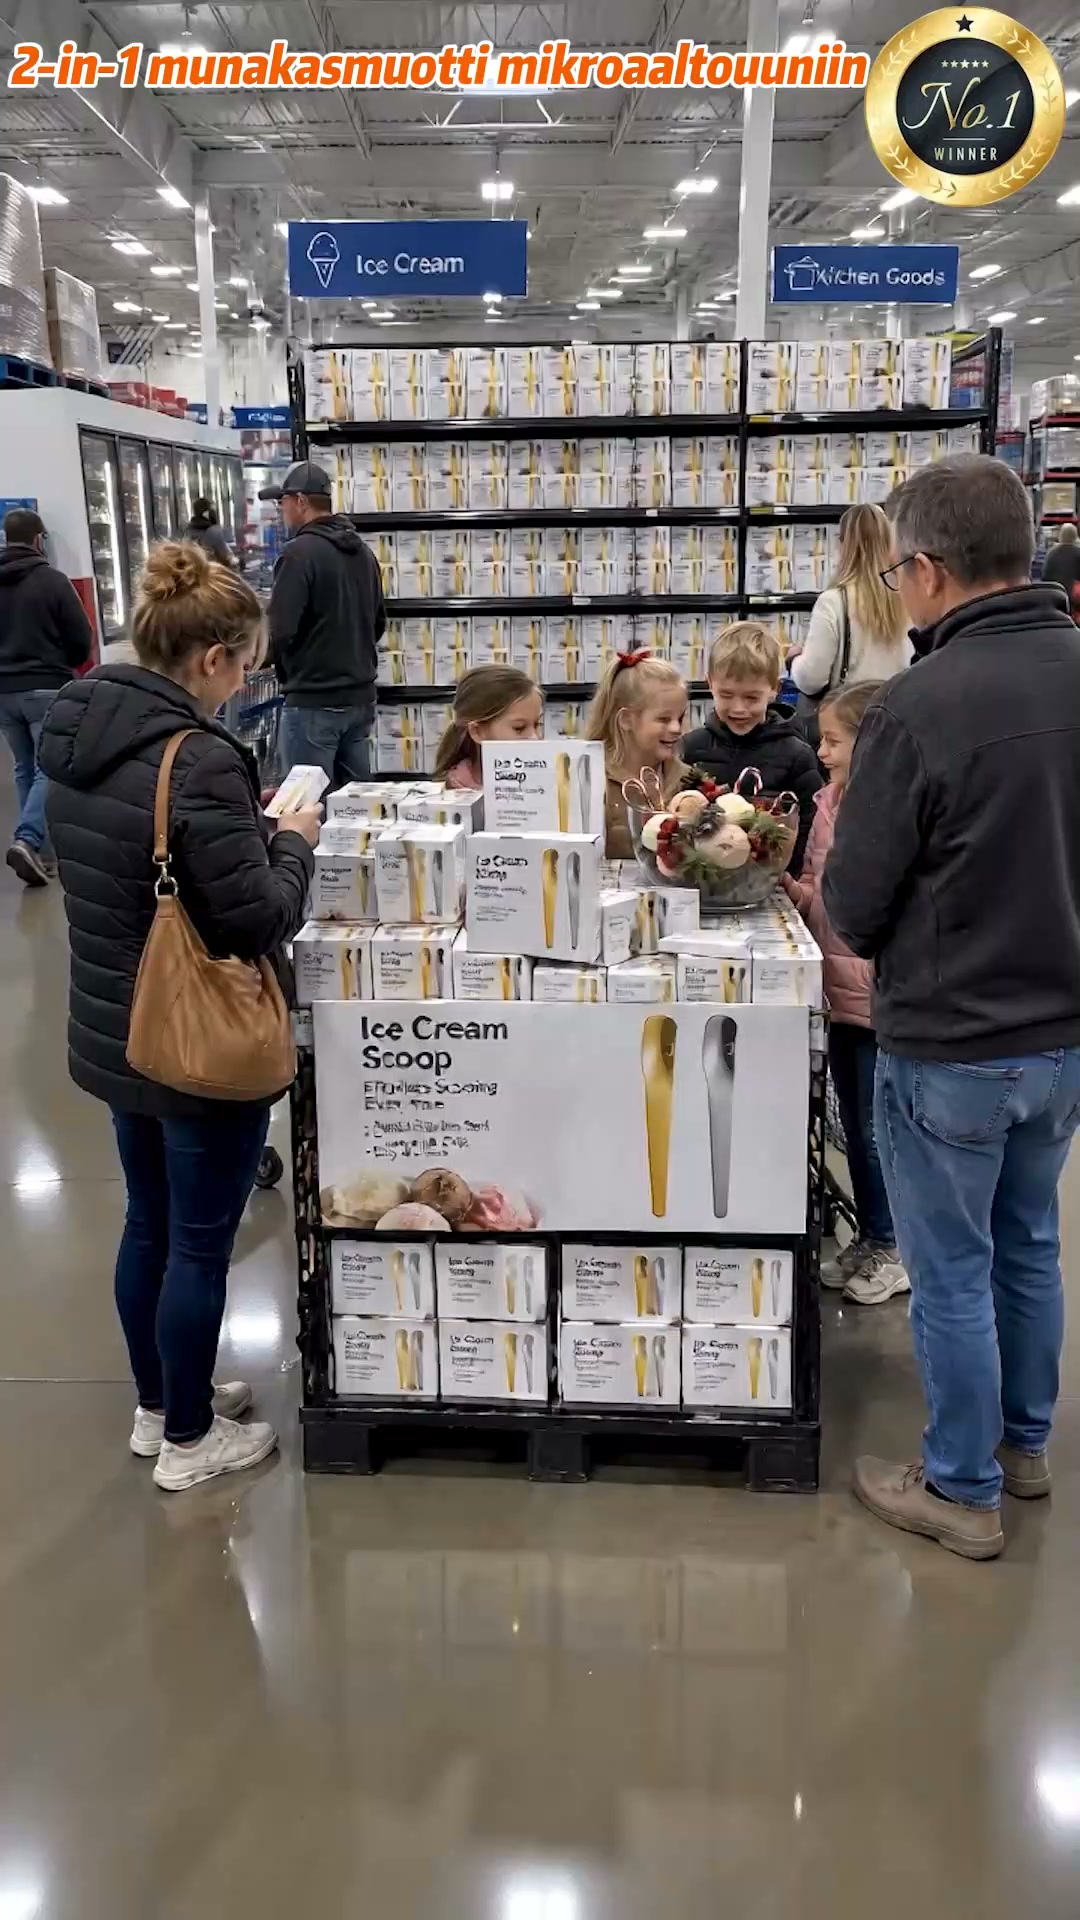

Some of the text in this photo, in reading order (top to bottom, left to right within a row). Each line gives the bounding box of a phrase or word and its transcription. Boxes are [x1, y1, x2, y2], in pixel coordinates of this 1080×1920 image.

[356, 252, 465, 275] Ice Cream
[815, 266, 946, 286] Kitchen Goods
[360, 1015, 509, 1041] Ice Cream
[362, 1045, 453, 1076] Scoop
